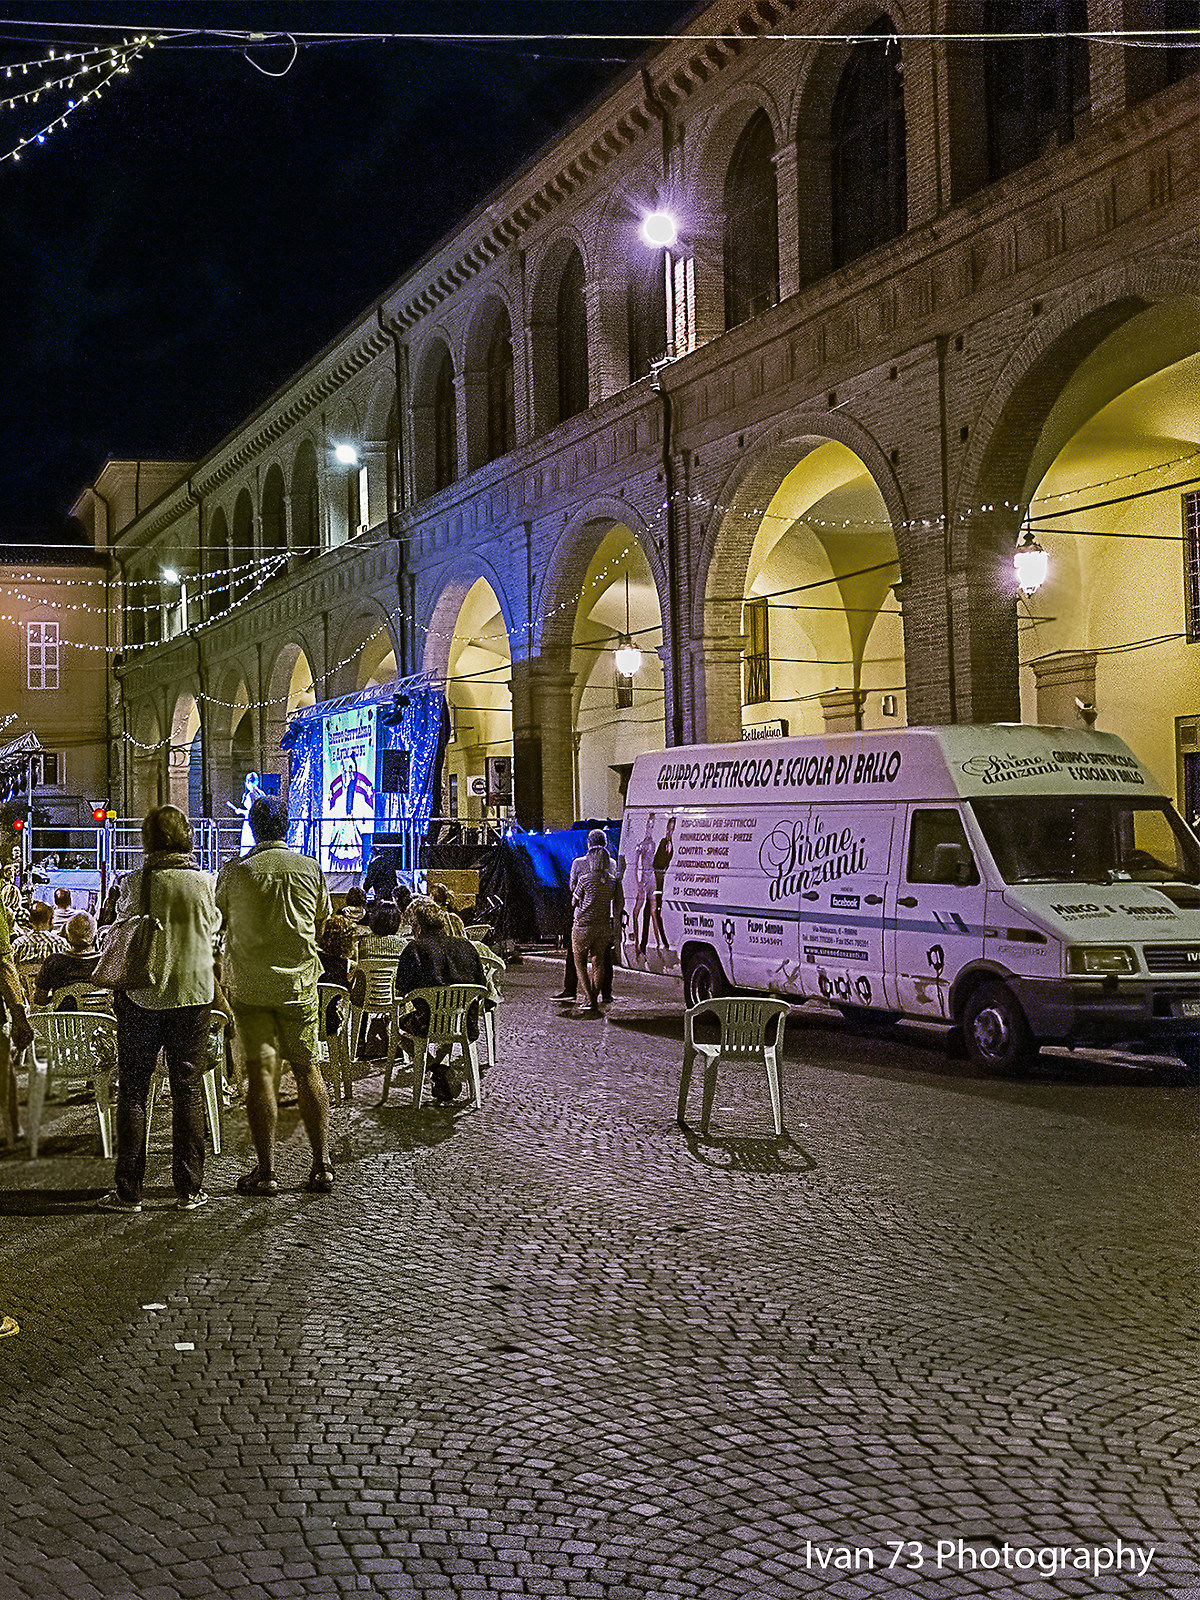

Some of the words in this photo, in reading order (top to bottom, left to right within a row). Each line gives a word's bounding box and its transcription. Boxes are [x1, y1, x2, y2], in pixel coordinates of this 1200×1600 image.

[657, 762, 700, 790] GRUPPO
[700, 759, 773, 789] SPETTACOLO
[773, 758, 784, 786] E
[783, 754, 834, 786] SCUOLA
[835, 754, 853, 784] DI
[853, 750, 901, 783] BALLO
[814, 815, 824, 835] le
[759, 820, 853, 878] Sirene
[769, 837, 869, 902] danzanti
[832, 896, 858, 908] facebook
[1050, 903, 1100, 915] MIRCO
